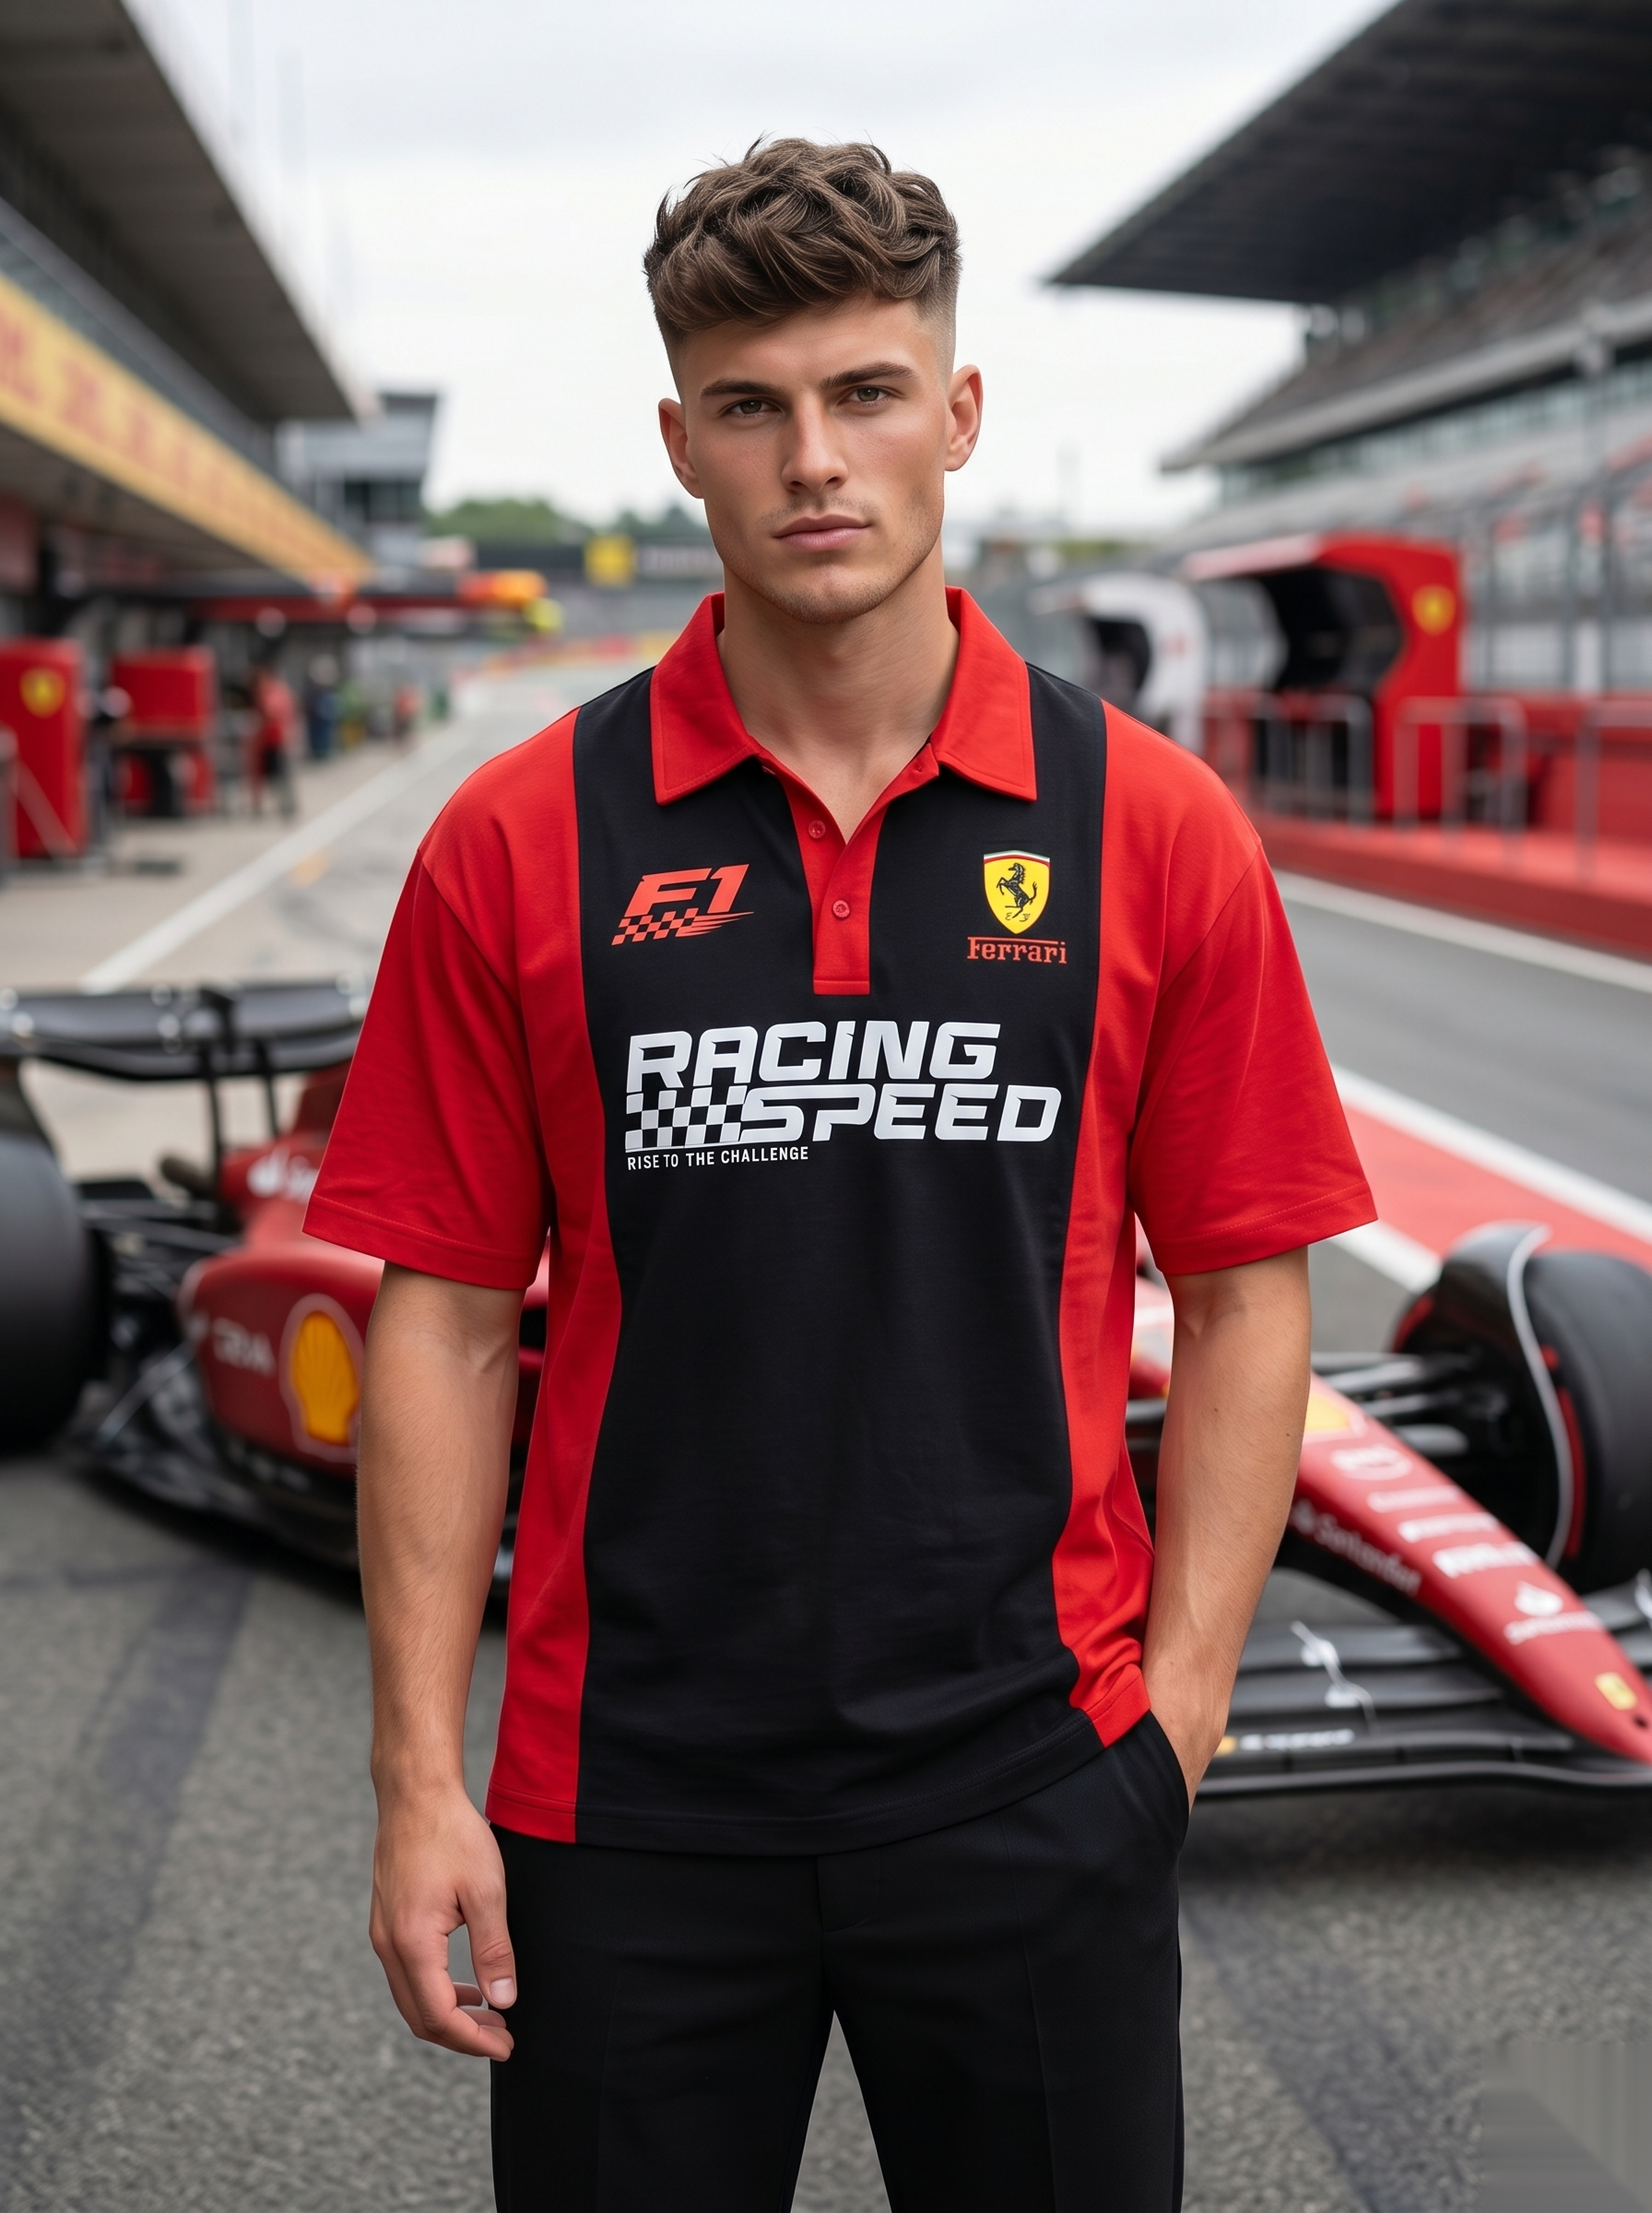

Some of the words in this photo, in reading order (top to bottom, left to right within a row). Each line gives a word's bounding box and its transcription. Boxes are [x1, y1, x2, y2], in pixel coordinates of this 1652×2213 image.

[623, 863, 749, 918] F1
[967, 936, 1067, 964] Ferrari
[626, 1020, 1001, 1094] RACING
[739, 1083, 1062, 1143] SPEED
[628, 1154, 660, 1170] RISE
[663, 1154, 679, 1168] TO
[686, 1151, 715, 1167] THE
[721, 1146, 808, 1165] CHALLENGE
